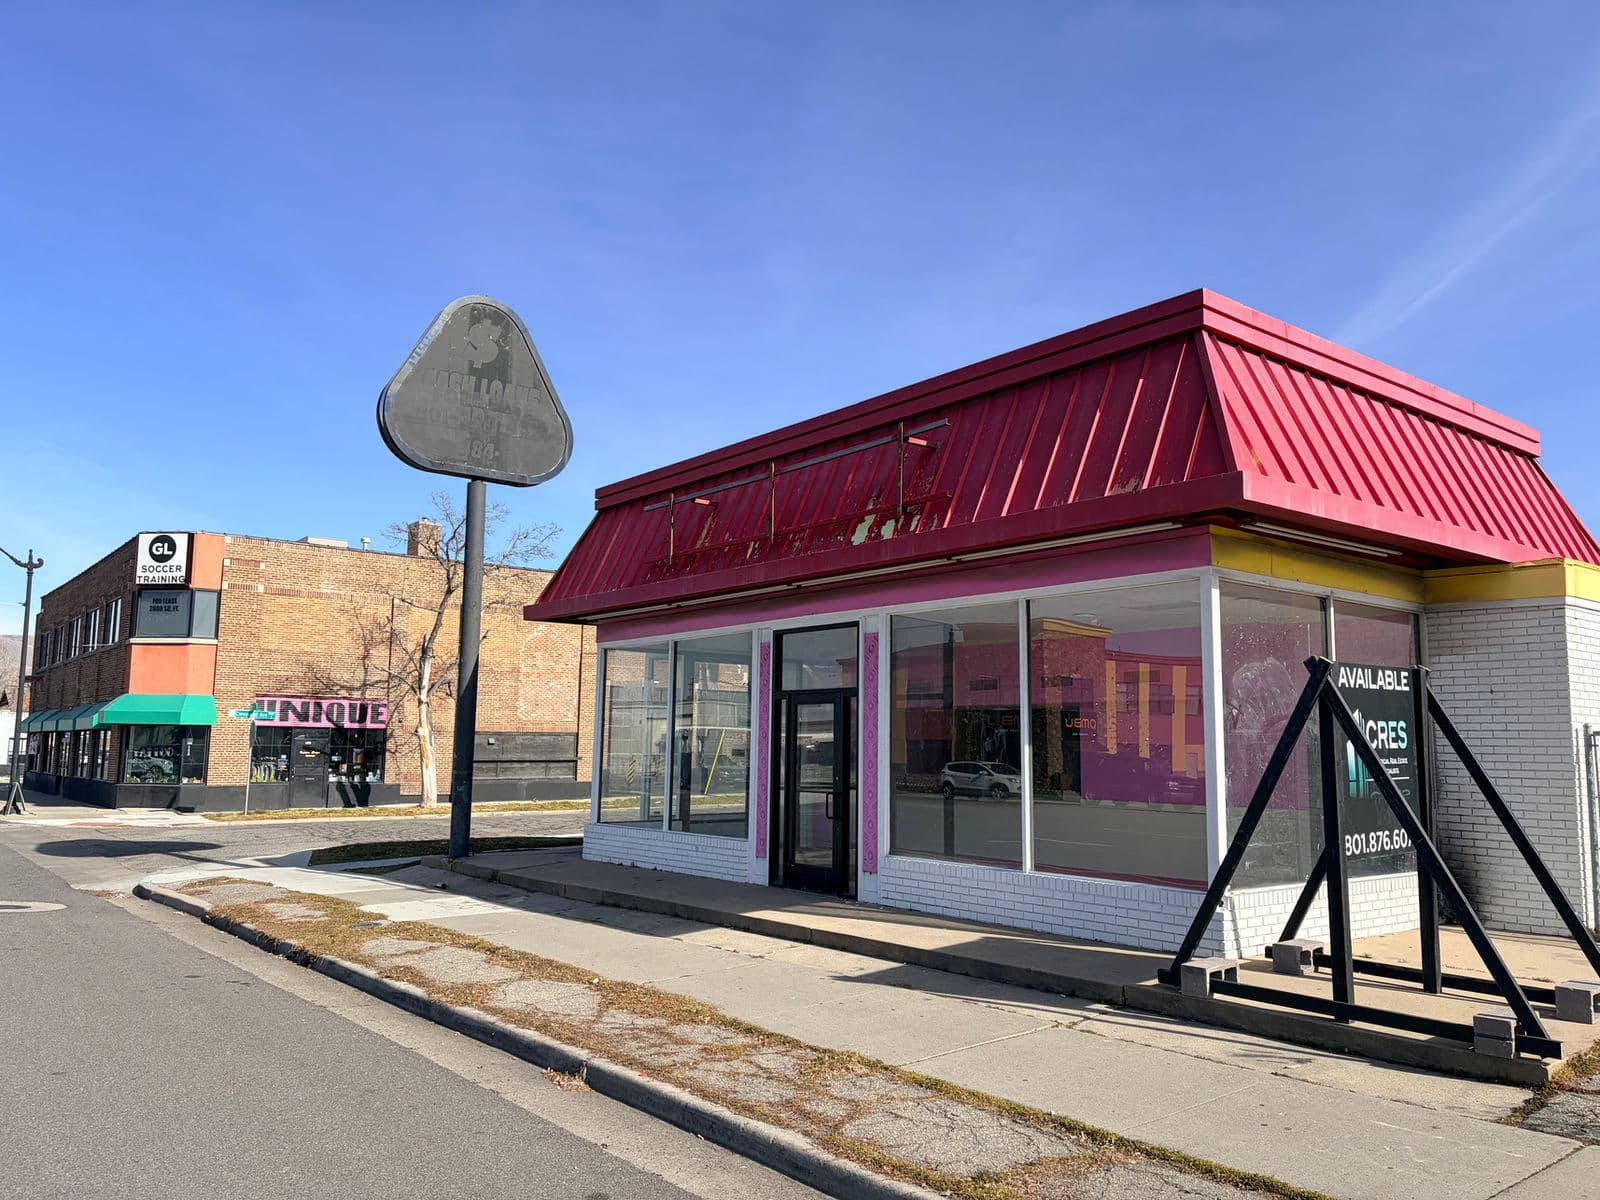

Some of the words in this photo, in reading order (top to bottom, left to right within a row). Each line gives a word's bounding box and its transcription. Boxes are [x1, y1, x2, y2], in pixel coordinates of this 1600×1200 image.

[152, 543, 173, 555] GL
[141, 565, 182, 573] SOCCER
[137, 575, 185, 583] TRAINING
[1338, 666, 1410, 691] AVAILABLE
[1366, 720, 1408, 750] CRES
